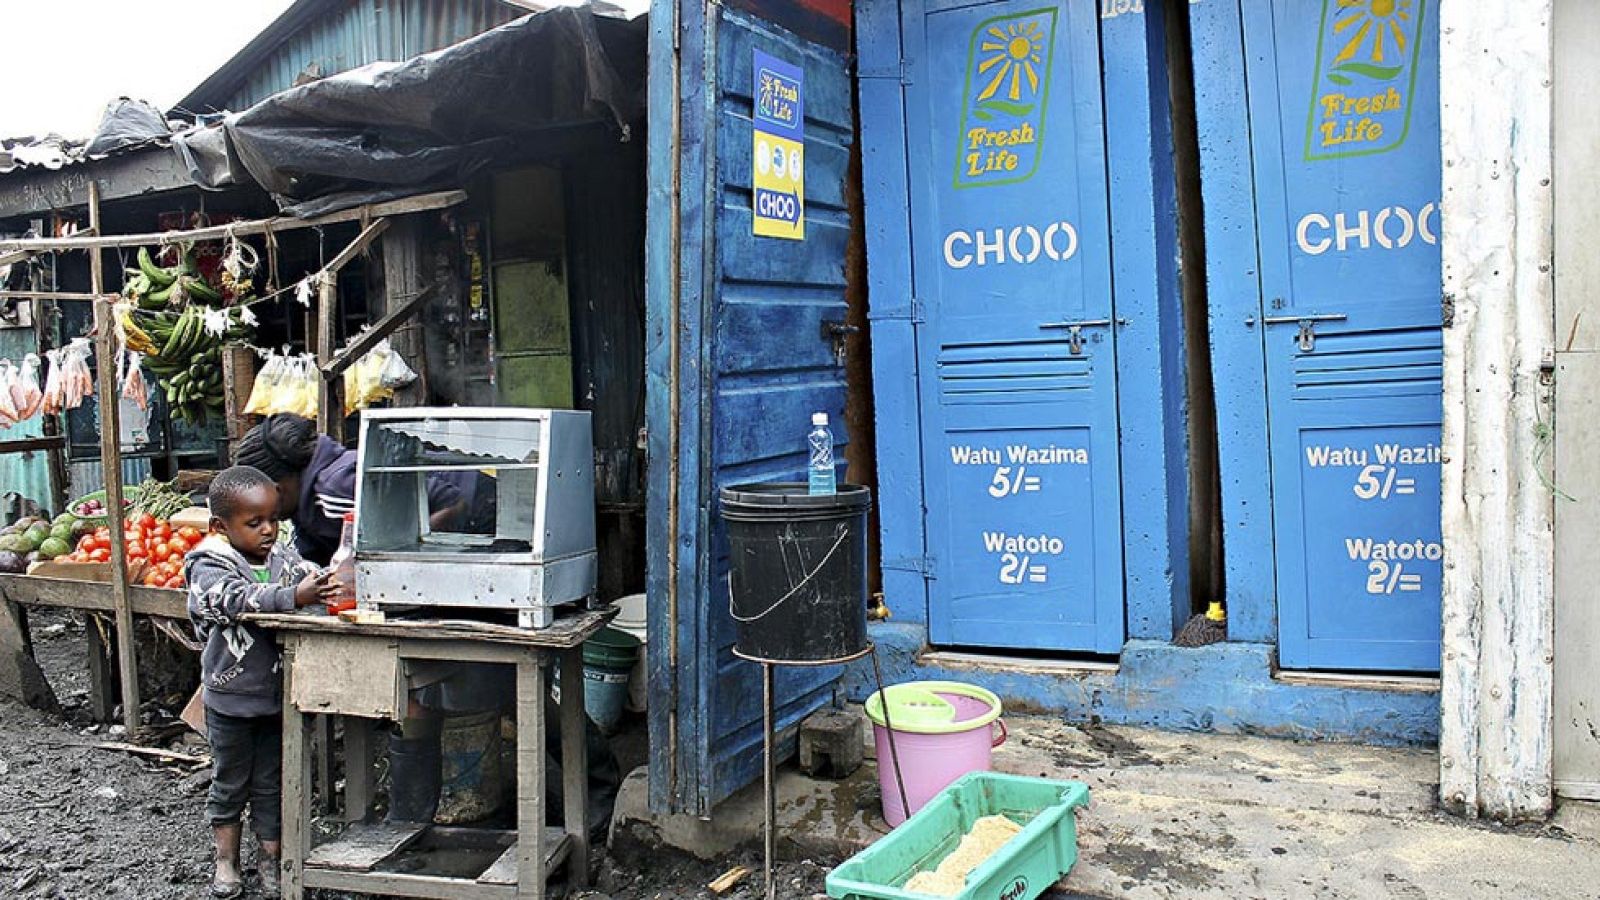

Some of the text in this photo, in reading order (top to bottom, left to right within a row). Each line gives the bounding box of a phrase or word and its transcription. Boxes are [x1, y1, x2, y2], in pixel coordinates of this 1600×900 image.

[774, 79, 799, 102] Fresh
[1320, 87, 1402, 119] Fresh
[773, 101, 793, 121] Life
[967, 122, 1035, 150] Fresh
[1320, 119, 1384, 147] Life
[966, 151, 1018, 176] Life
[759, 192, 795, 220] CHOO
[943, 221, 1078, 269] CHOO
[950, 444, 1089, 465] Watu Wazima
[1306, 445, 1367, 467] Watu
[988, 466, 1041, 498] 5/=
[1353, 464, 1415, 500] 5/=
[982, 531, 1064, 554] Watoto
[1344, 538, 1443, 561] Watoto
[999, 553, 1047, 584] 2/=
[1366, 560, 1422, 594] 2/=
